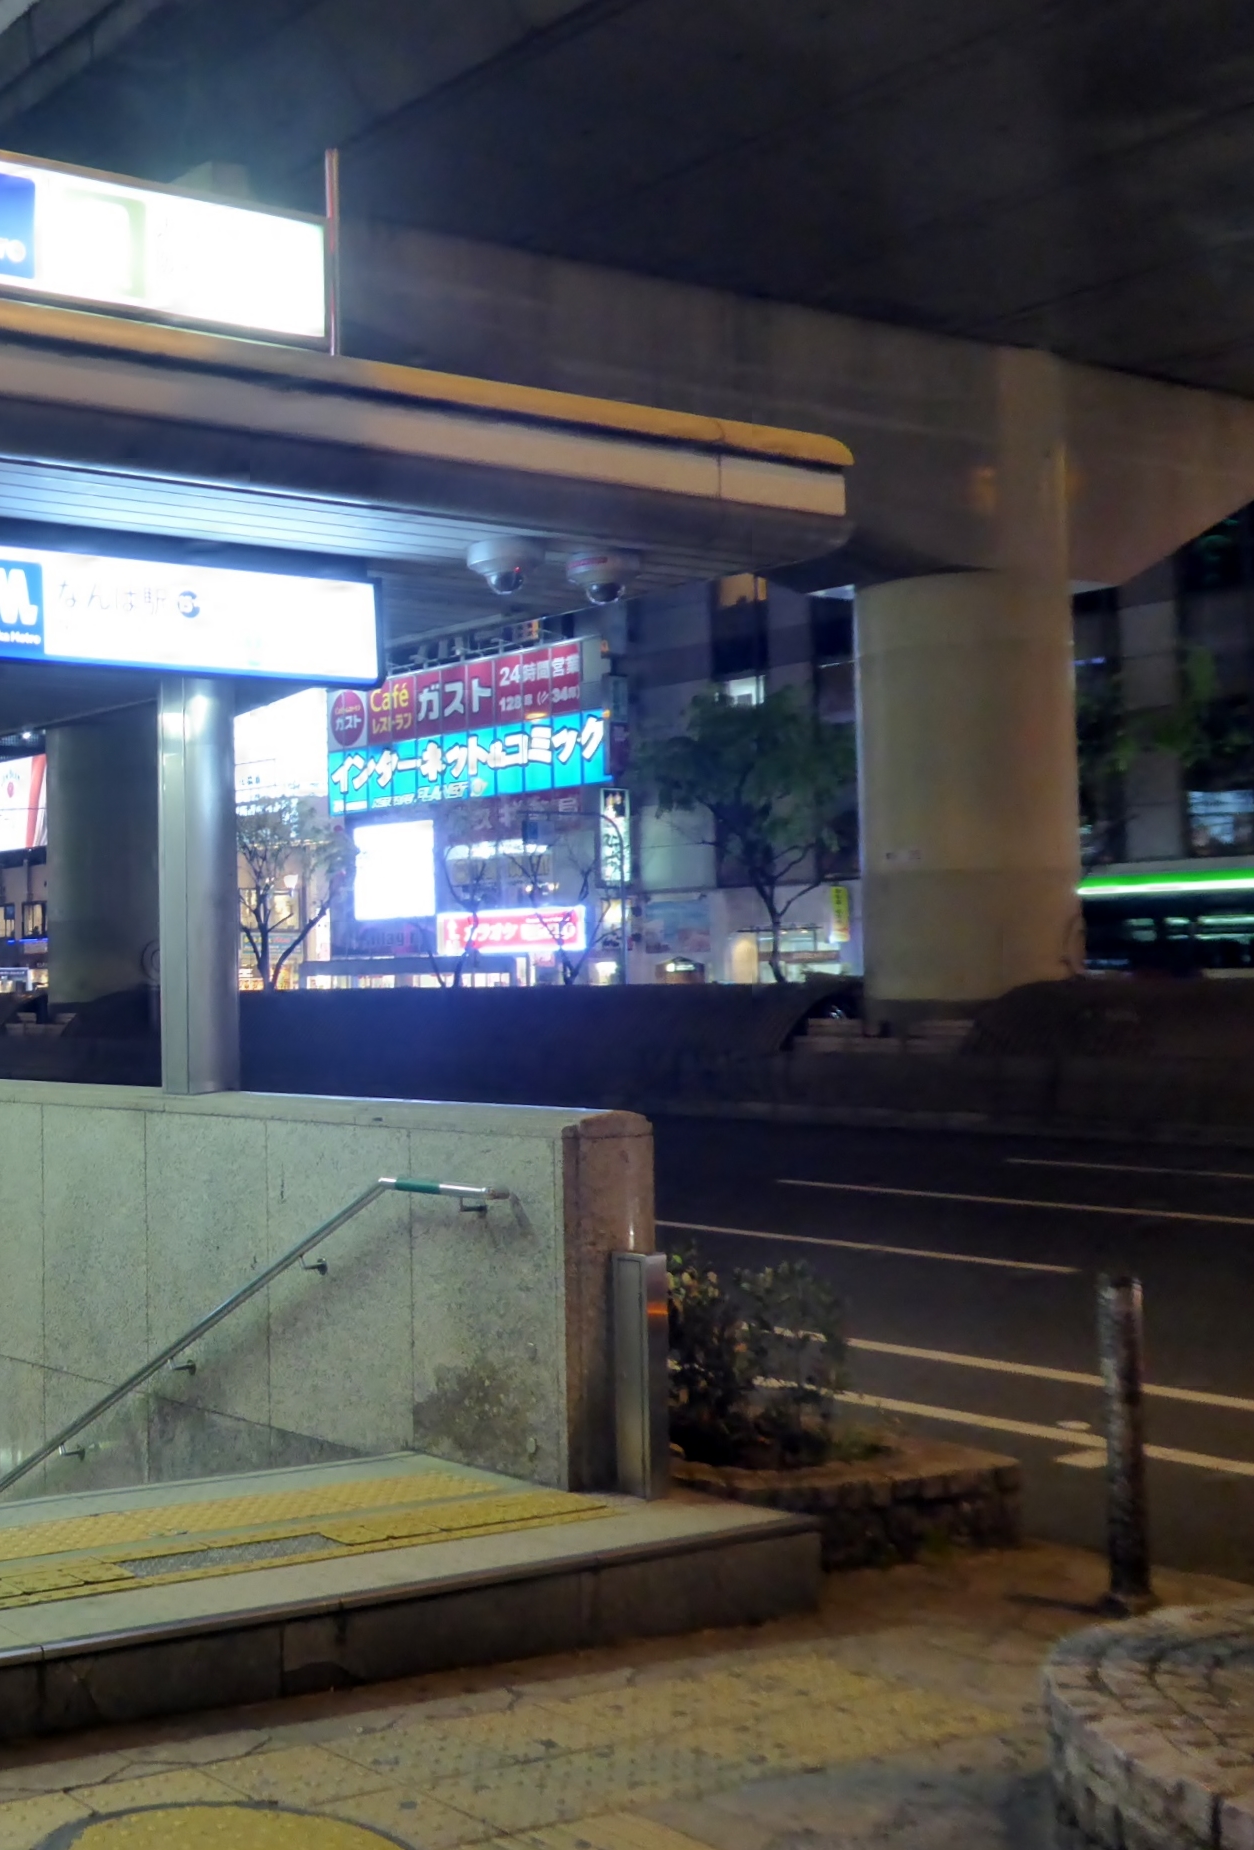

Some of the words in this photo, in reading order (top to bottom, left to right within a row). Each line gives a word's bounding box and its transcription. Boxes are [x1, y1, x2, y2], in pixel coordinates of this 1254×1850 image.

[499, 653, 579, 686] 24時間営業
[370, 682, 410, 713] Café
[417, 678, 492, 722] ガスト
[372, 712, 413, 734] レストラン
